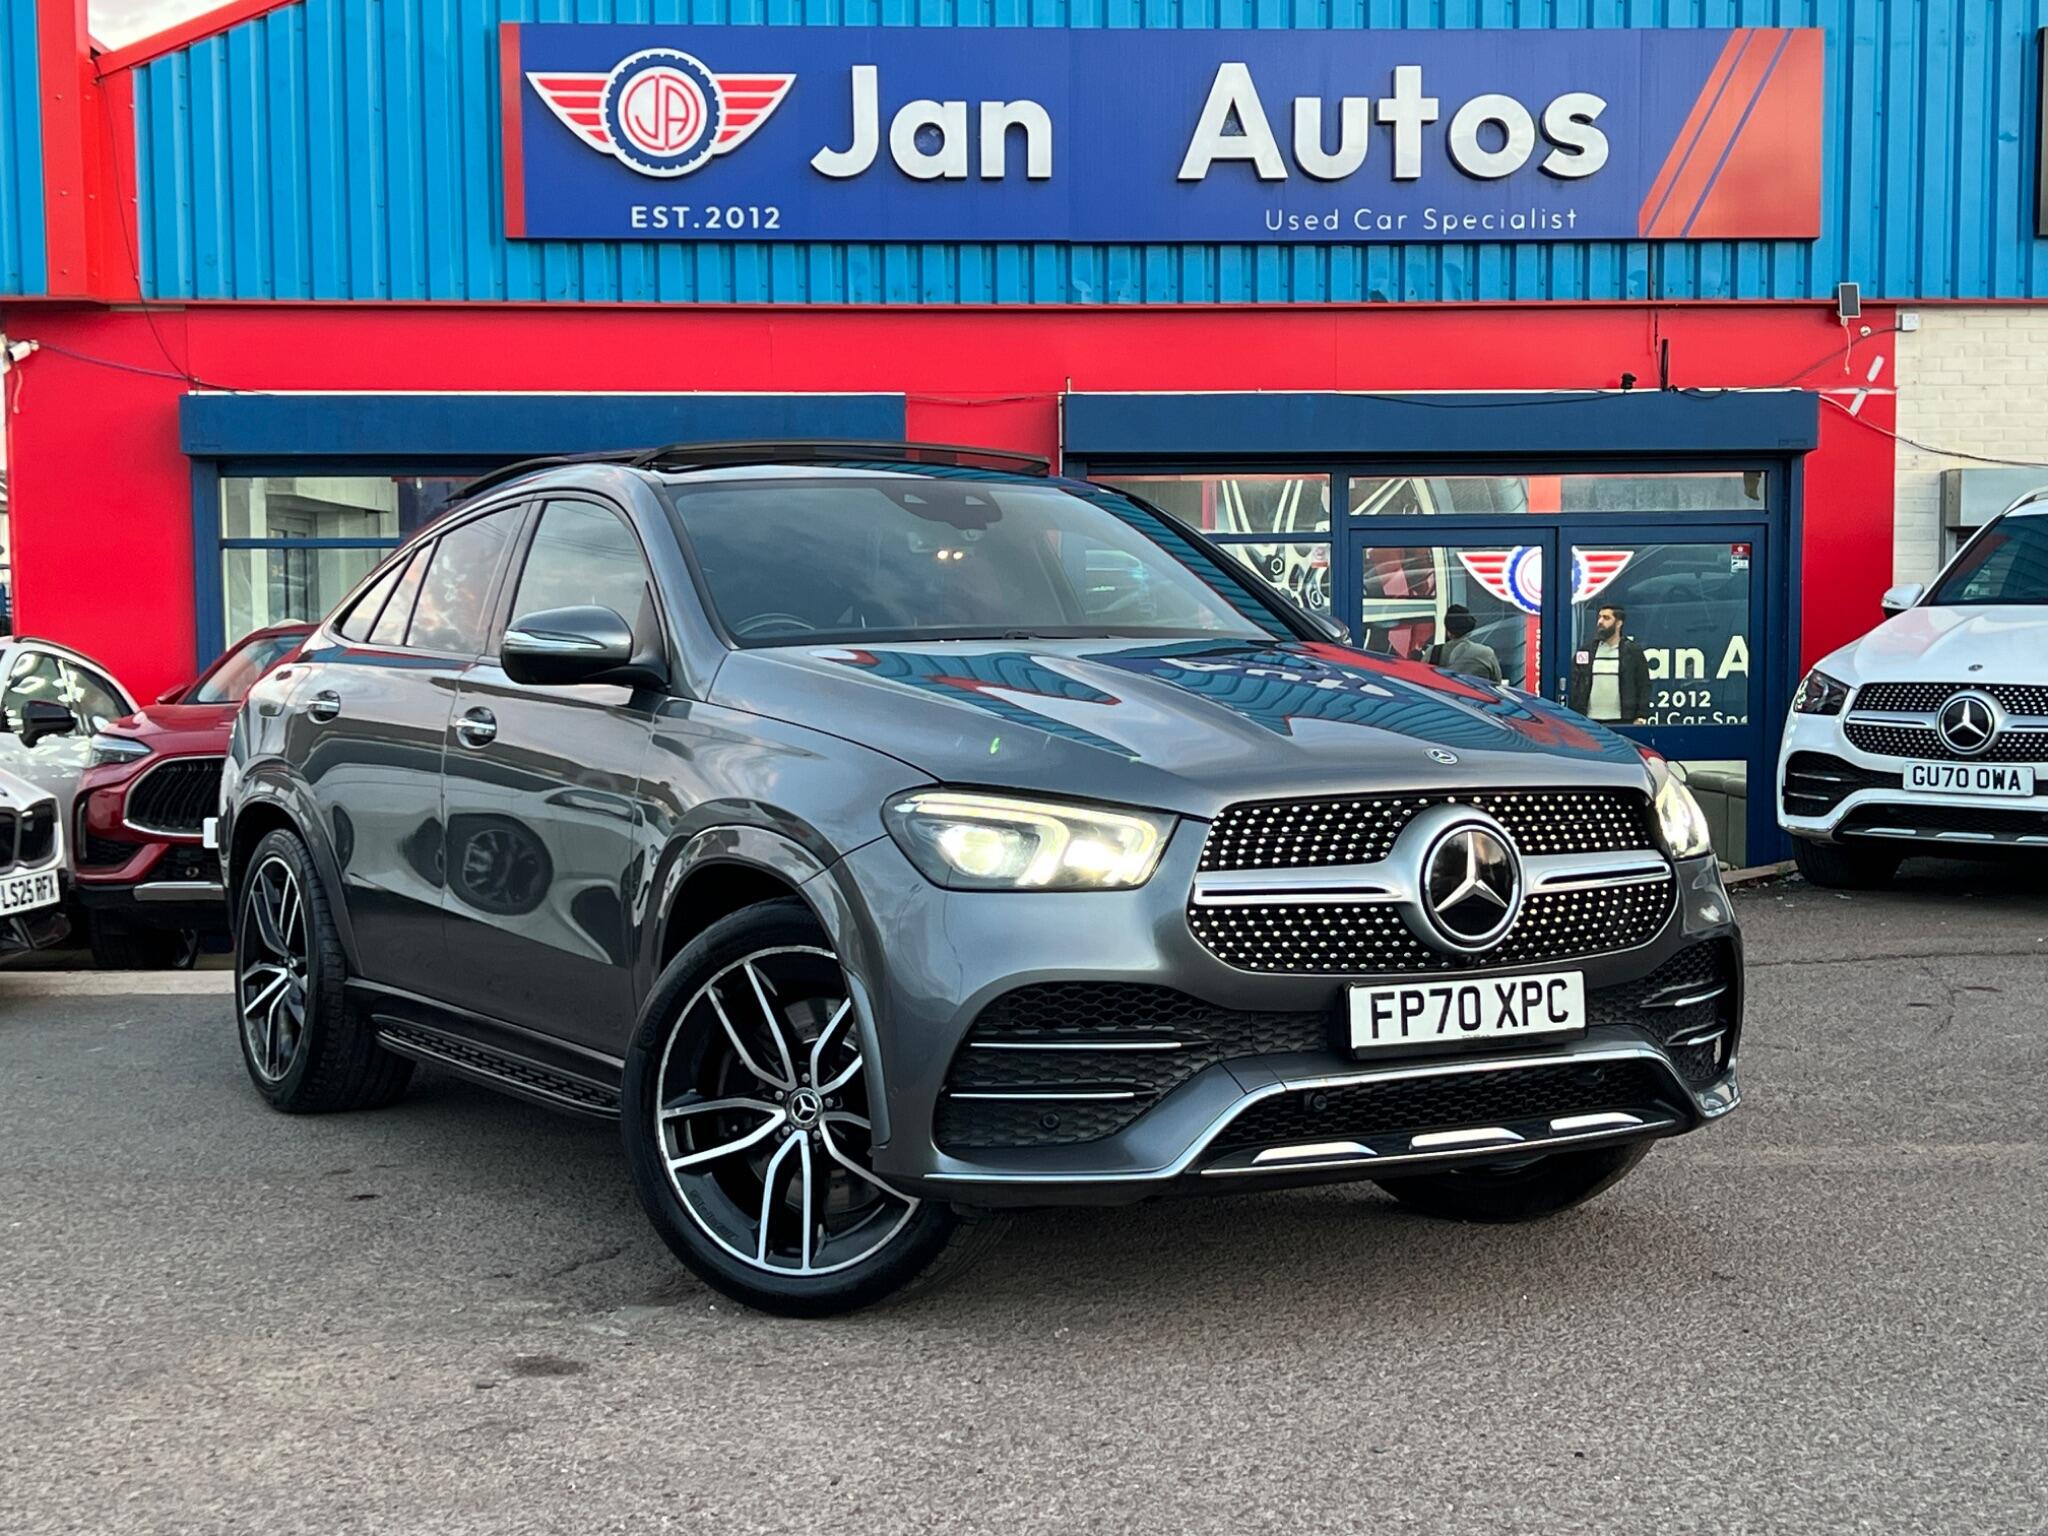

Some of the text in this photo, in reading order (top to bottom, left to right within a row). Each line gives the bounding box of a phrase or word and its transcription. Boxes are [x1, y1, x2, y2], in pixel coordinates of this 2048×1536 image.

[810, 62, 1610, 181] Jan Autos
[631, 205, 781, 229] EST.2012
[1265, 207, 1577, 235] Used Car Specialist
[1627, 635, 1705, 680] an
[1912, 765, 2021, 791] GU70 OWA
[1, 879, 34, 909] LS25
[1370, 978, 1569, 1039] FP70 XPC
